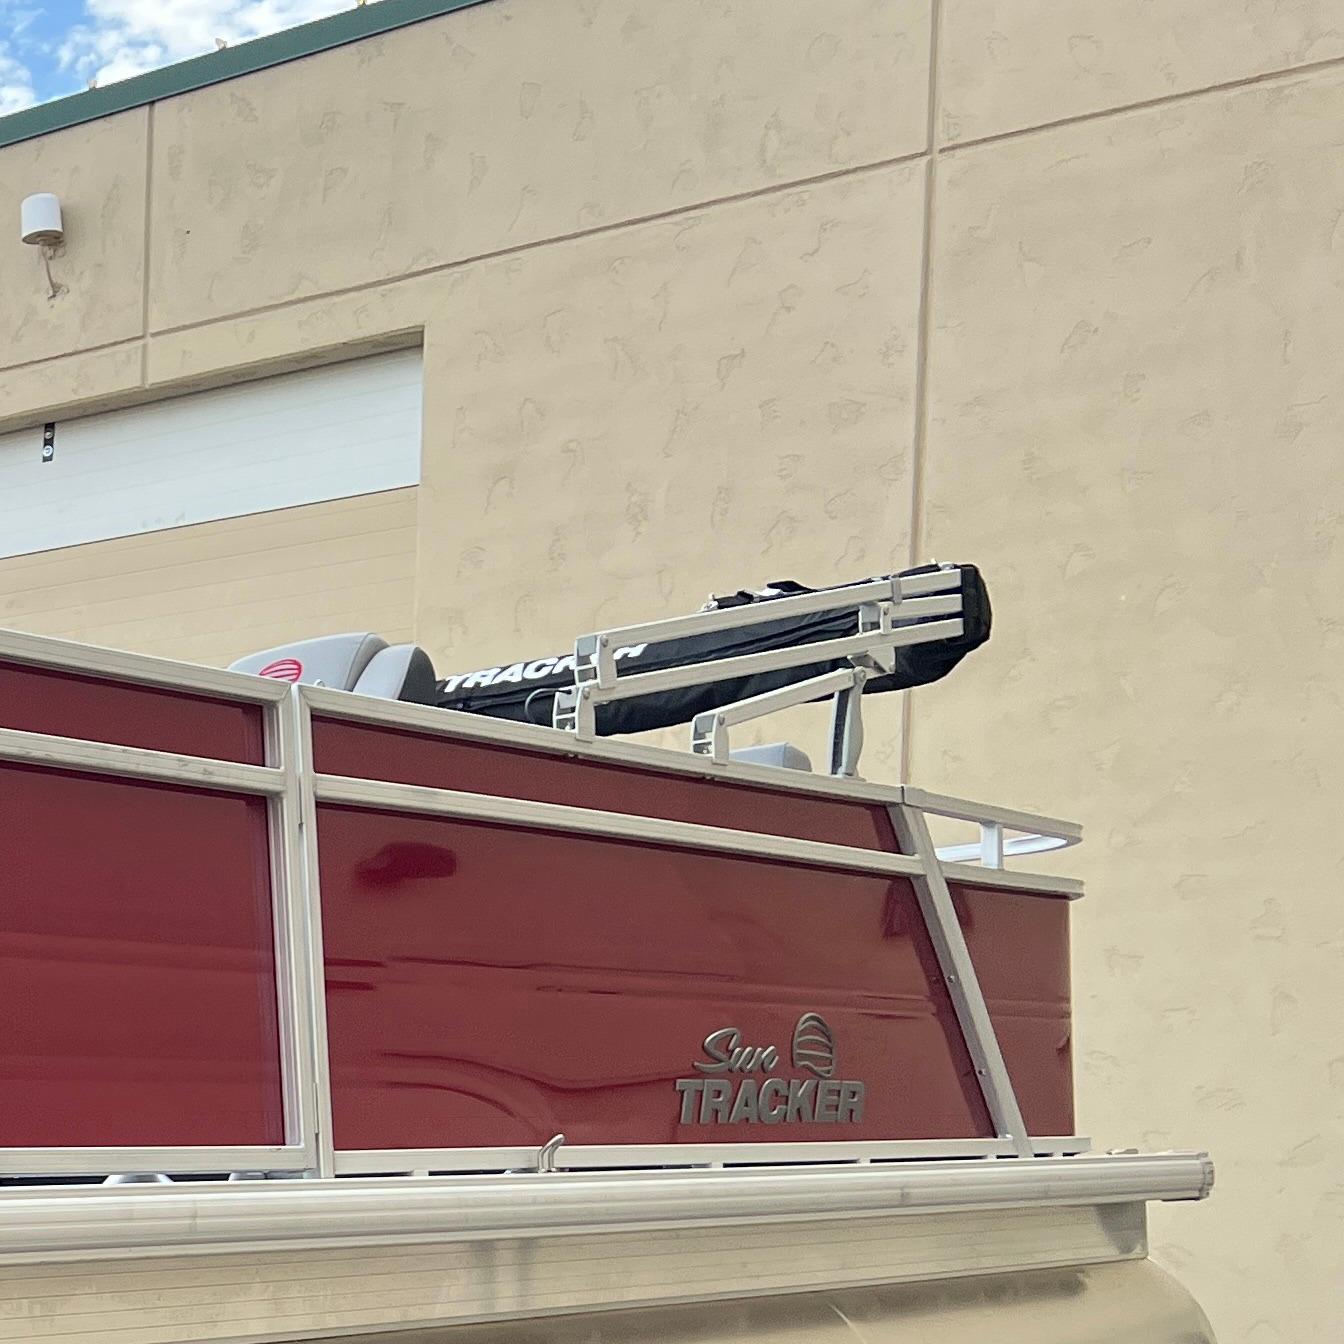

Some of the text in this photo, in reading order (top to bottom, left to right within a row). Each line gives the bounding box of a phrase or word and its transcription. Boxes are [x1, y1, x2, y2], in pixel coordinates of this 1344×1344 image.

[444, 643, 648, 693] TRACK
[693, 1027, 780, 1074] Sun
[675, 1078, 867, 1126] TRACKER
